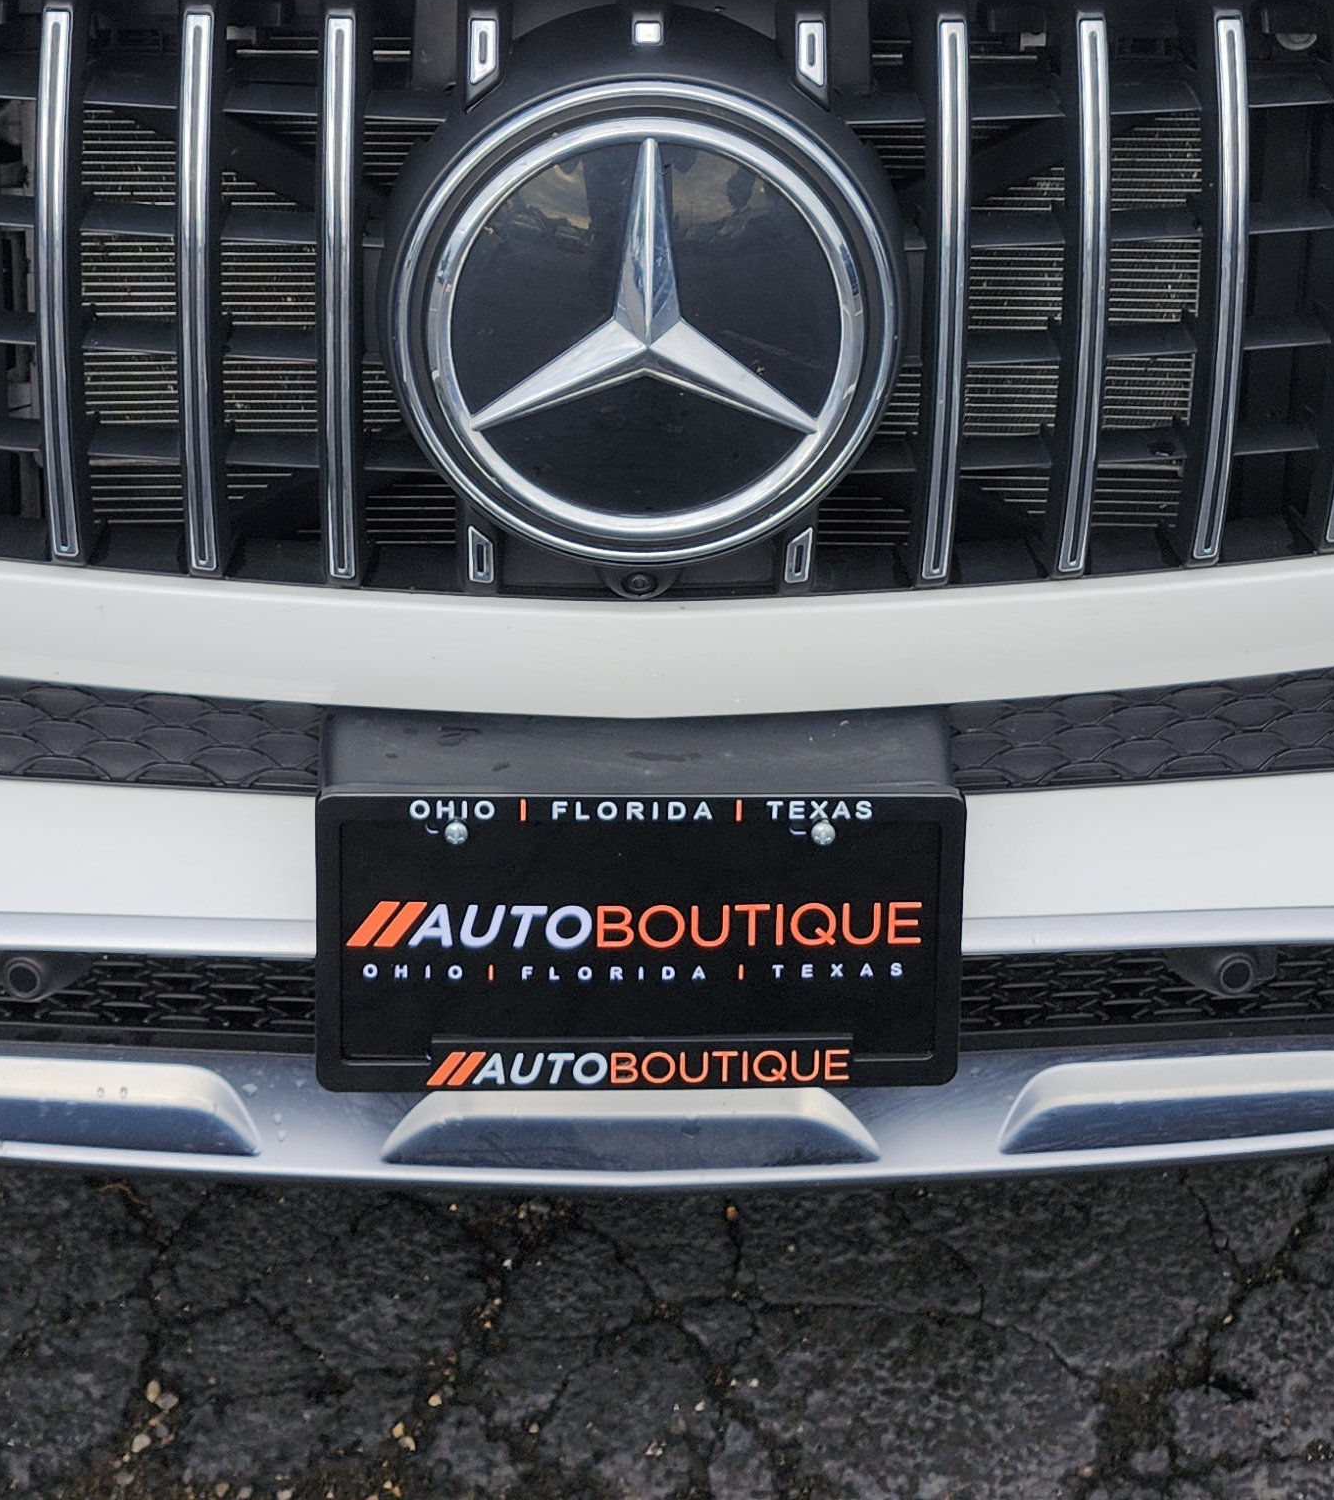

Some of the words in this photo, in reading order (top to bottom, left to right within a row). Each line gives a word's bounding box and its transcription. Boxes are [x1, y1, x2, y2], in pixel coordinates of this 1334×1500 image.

[409, 800, 496, 820] OHIO
[551, 800, 713, 821] FLORIDA
[766, 800, 873, 820] TEXAS
[408, 901, 923, 949] AUTOBOUTIQUE
[362, 963, 463, 980] OHIO
[521, 965, 706, 981] FLORIDA
[772, 962, 903, 979] TEXAS
[471, 1049, 850, 1085] AUTOBOUTIQUE
